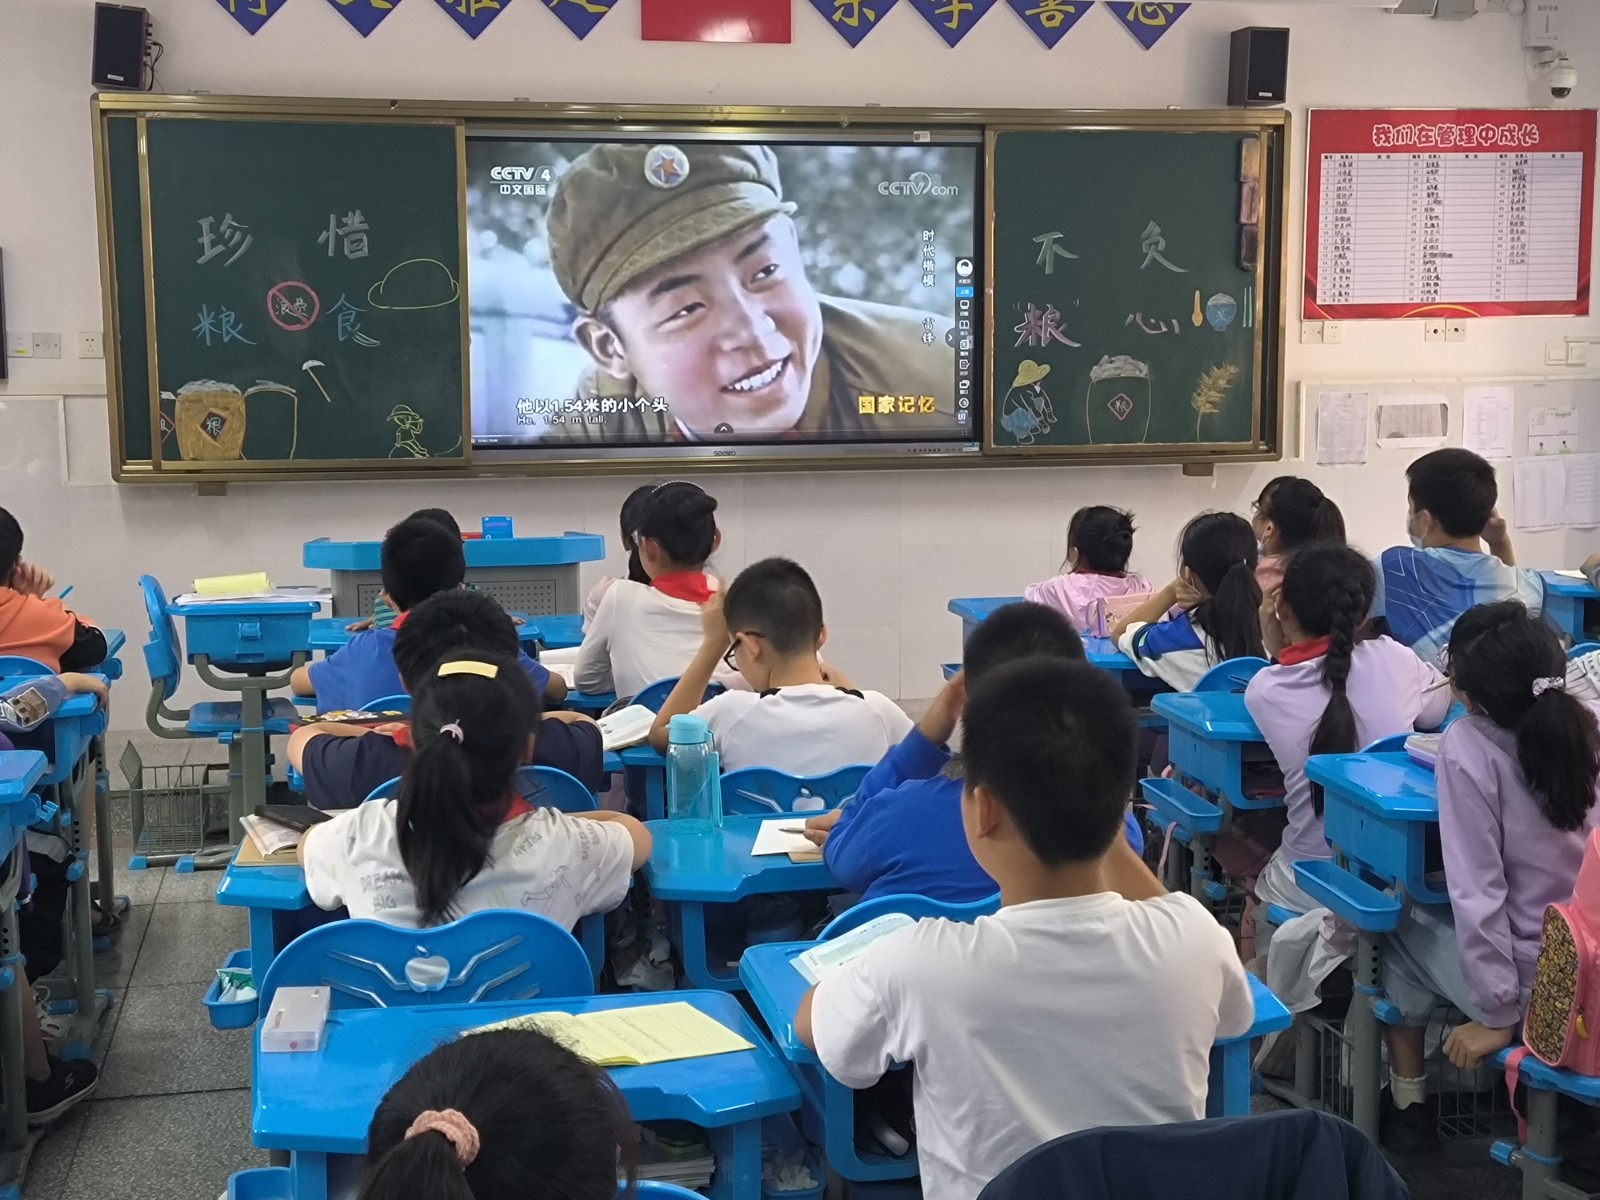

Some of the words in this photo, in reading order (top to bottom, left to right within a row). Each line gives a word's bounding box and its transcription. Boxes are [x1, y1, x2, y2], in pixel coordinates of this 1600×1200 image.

[1372, 124, 1539, 147] 我们在管理中成长
[490, 166, 535, 181] CCTV
[541, 169, 551, 182] 4
[500, 184, 547, 196] 中文国际
[922, 229, 936, 288] 时代楷模
[516, 397, 669, 415] 他以1.54米的小个头
[858, 395, 936, 415] 国家记忆
[372, 894, 398, 913] BIG
